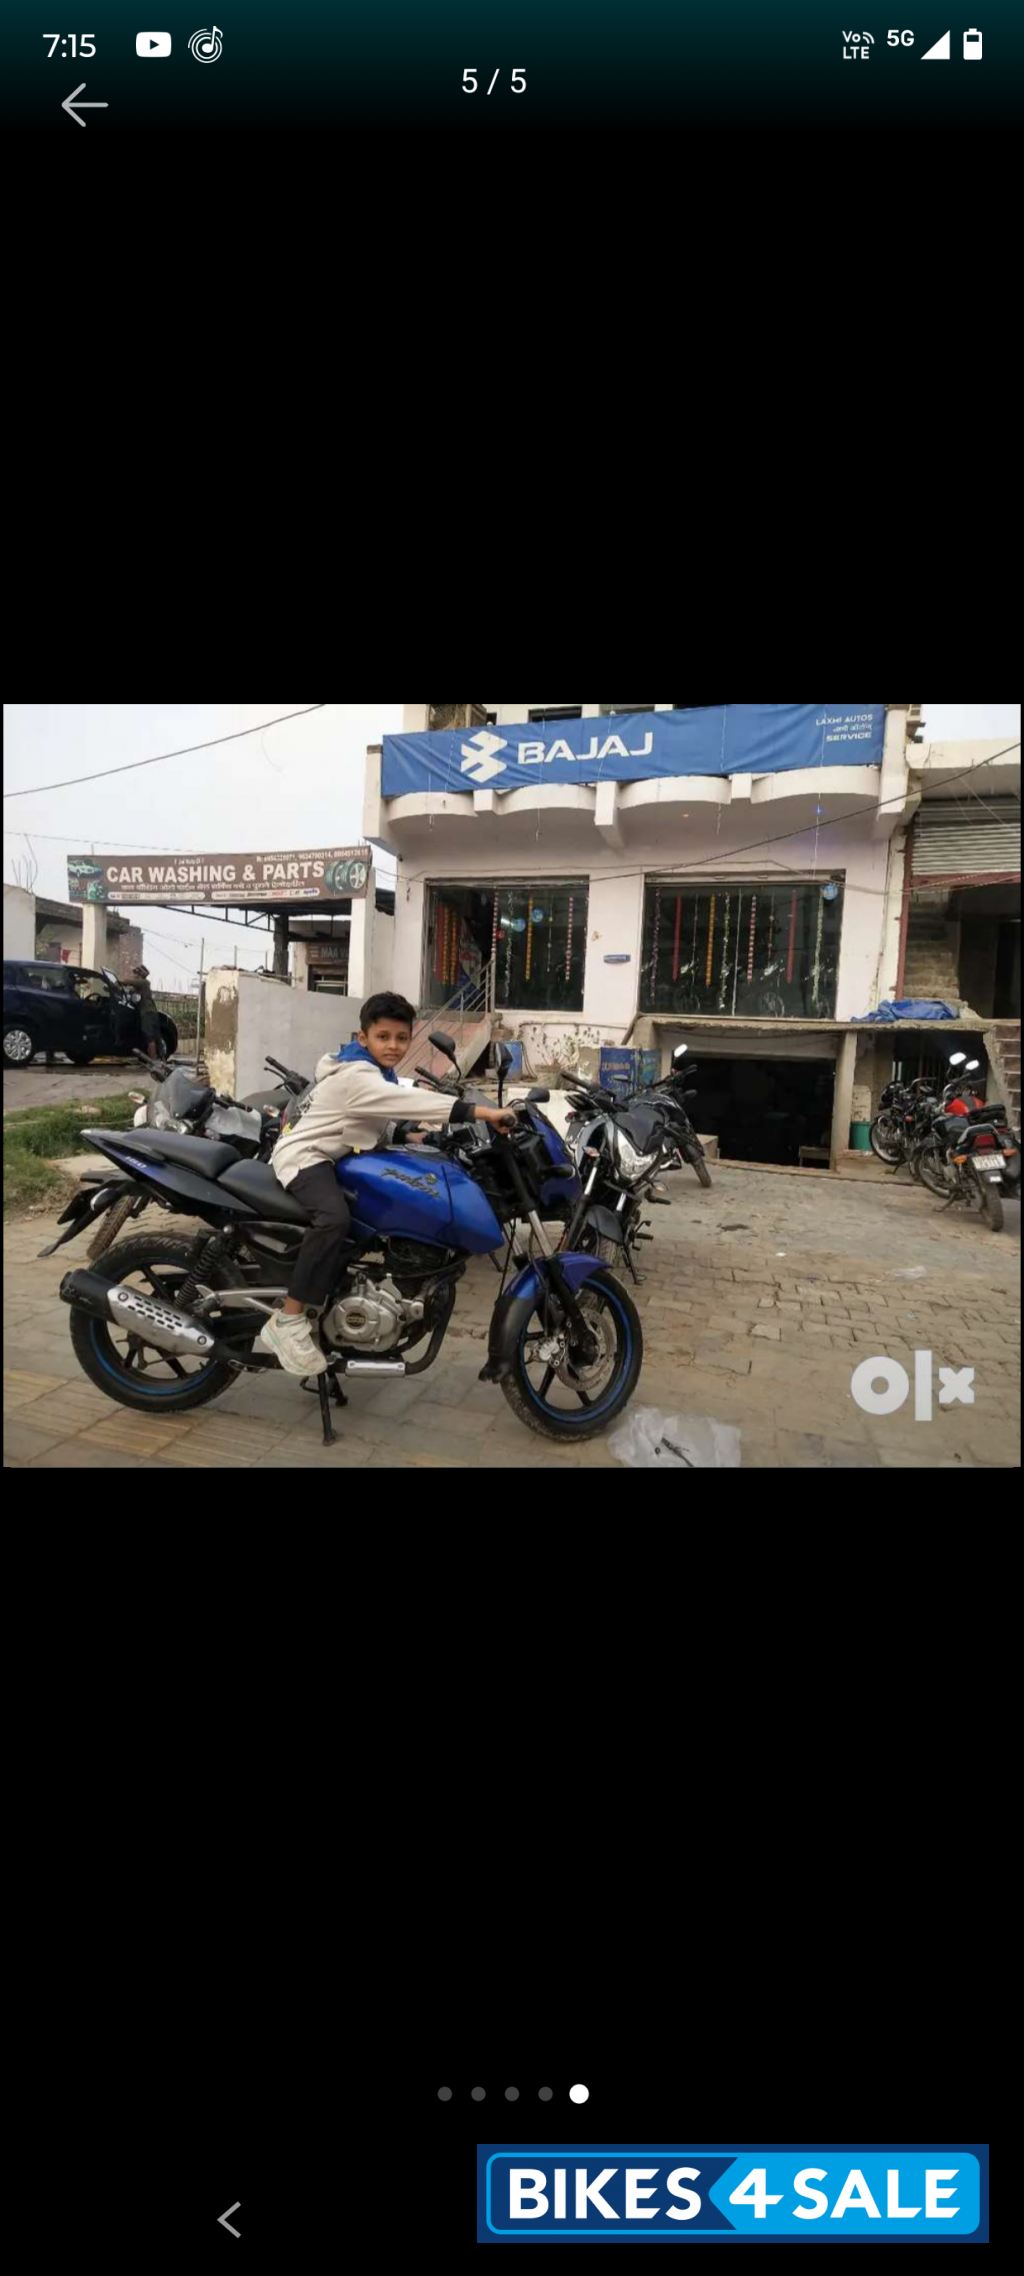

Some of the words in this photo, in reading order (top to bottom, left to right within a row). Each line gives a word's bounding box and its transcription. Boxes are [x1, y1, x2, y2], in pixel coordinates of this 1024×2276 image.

[816, 716, 842, 726] LAXMI
[844, 713, 873, 723] AUTOS
[826, 732, 872, 742] SERVICE
[517, 731, 653, 764] BAJAJ
[106, 866, 143, 883] CAR
[148, 864, 236, 884] WASHING
[242, 864, 256, 881] &
[263, 861, 325, 881] PARTS
